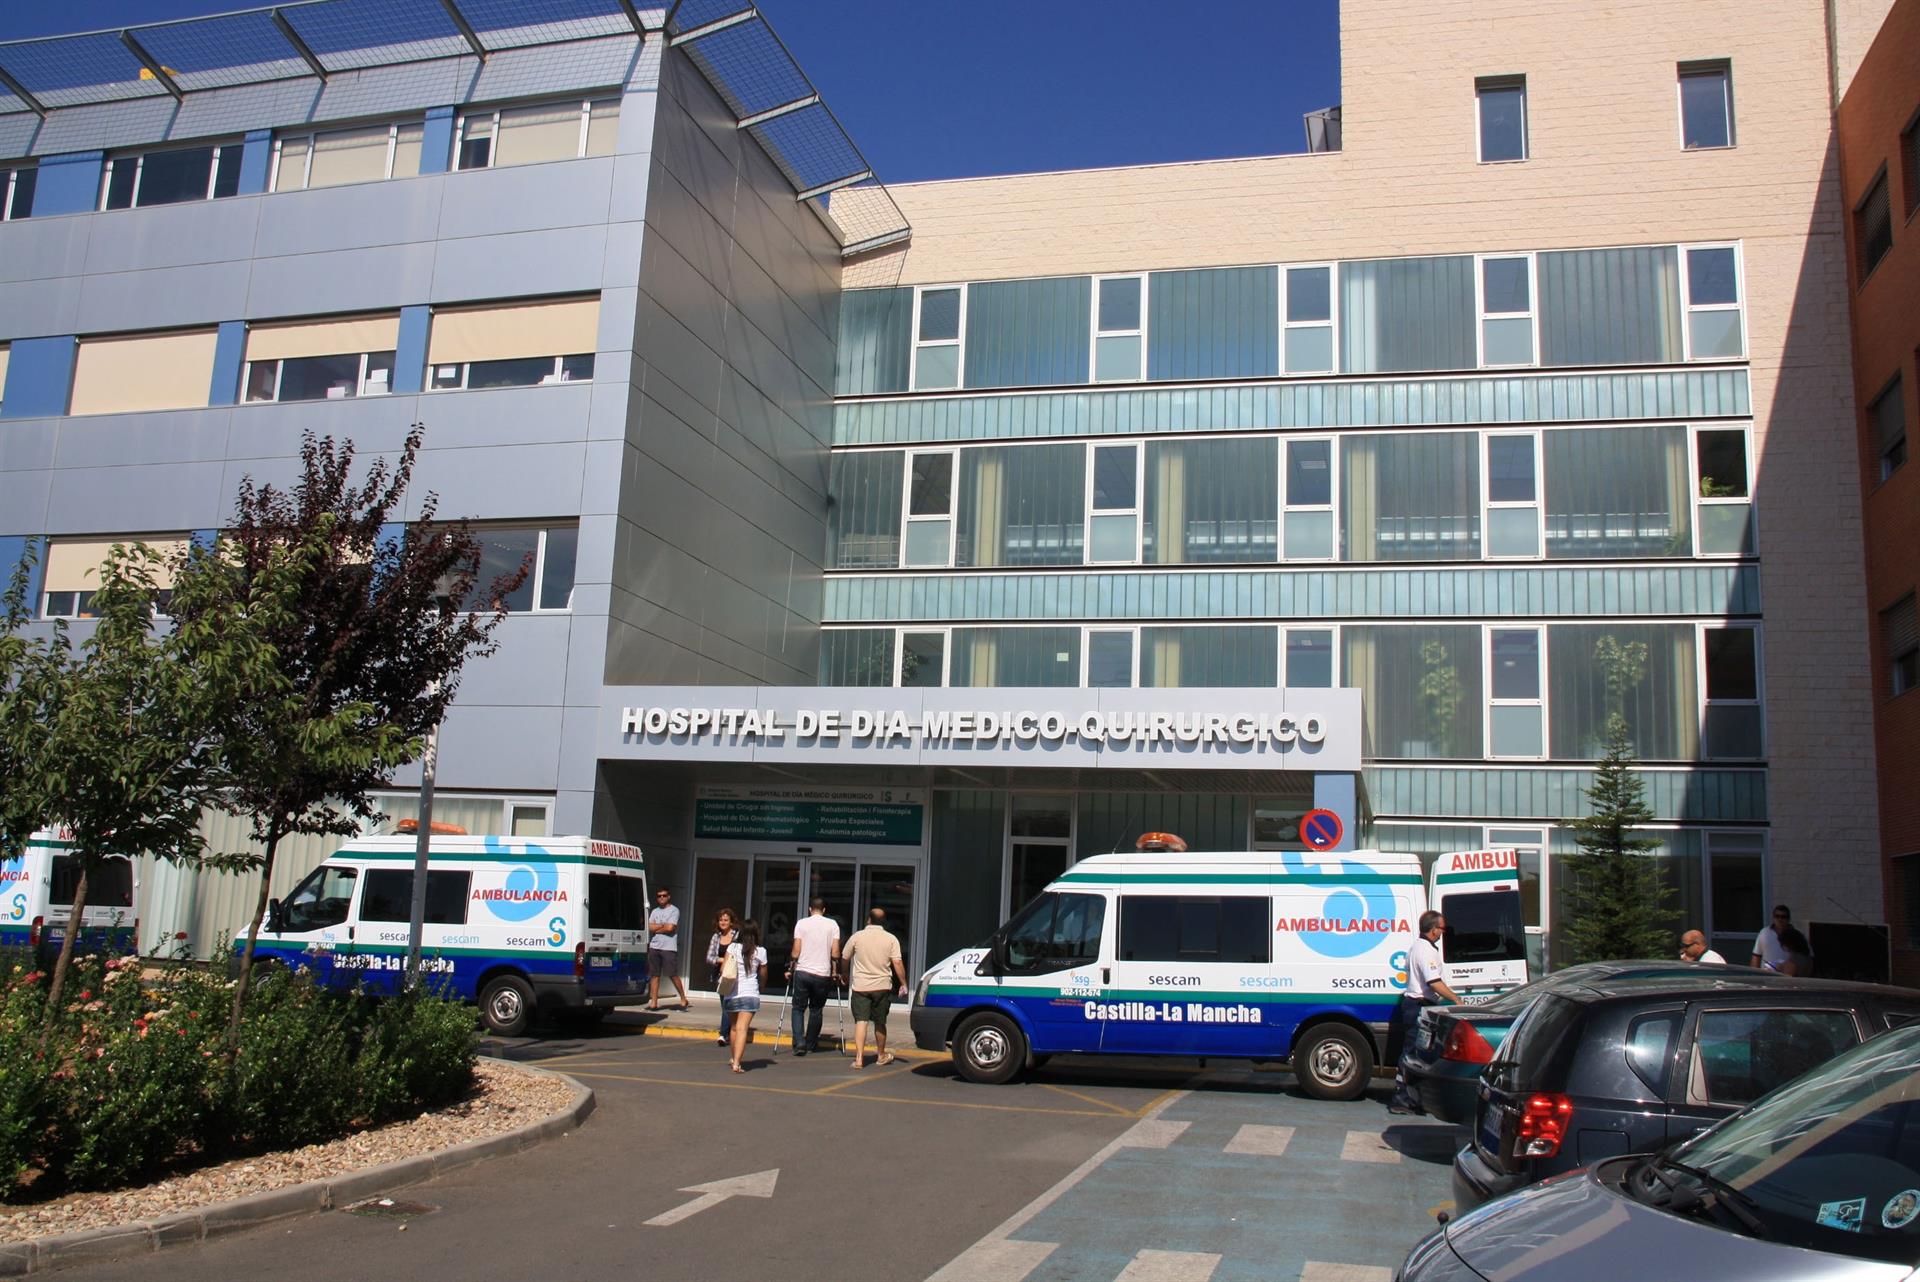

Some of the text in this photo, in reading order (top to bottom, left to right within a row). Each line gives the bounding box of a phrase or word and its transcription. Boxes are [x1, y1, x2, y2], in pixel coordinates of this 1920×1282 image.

[621, 706, 1328, 748] HOSPITAL DE DIA MEDICO-QUIRURGICO
[749, 790, 780, 798] HOSPITAL
[703, 814, 729, 822] Hospital
[591, 842, 641, 861] AMBULANCIA
[471, 889, 568, 902] AMBULANCIA
[1276, 917, 1412, 933] AMBULANCIA
[379, 932, 410, 943] sesca
[441, 933, 480, 945] sescam
[506, 936, 546, 948] sescam
[962, 952, 981, 965] 122
[1148, 974, 1202, 987] sescam
[1239, 975, 1294, 989] sescam
[1331, 976, 1387, 990] sescam
[1084, 1000, 1262, 1025] Castilla-La Mancha
